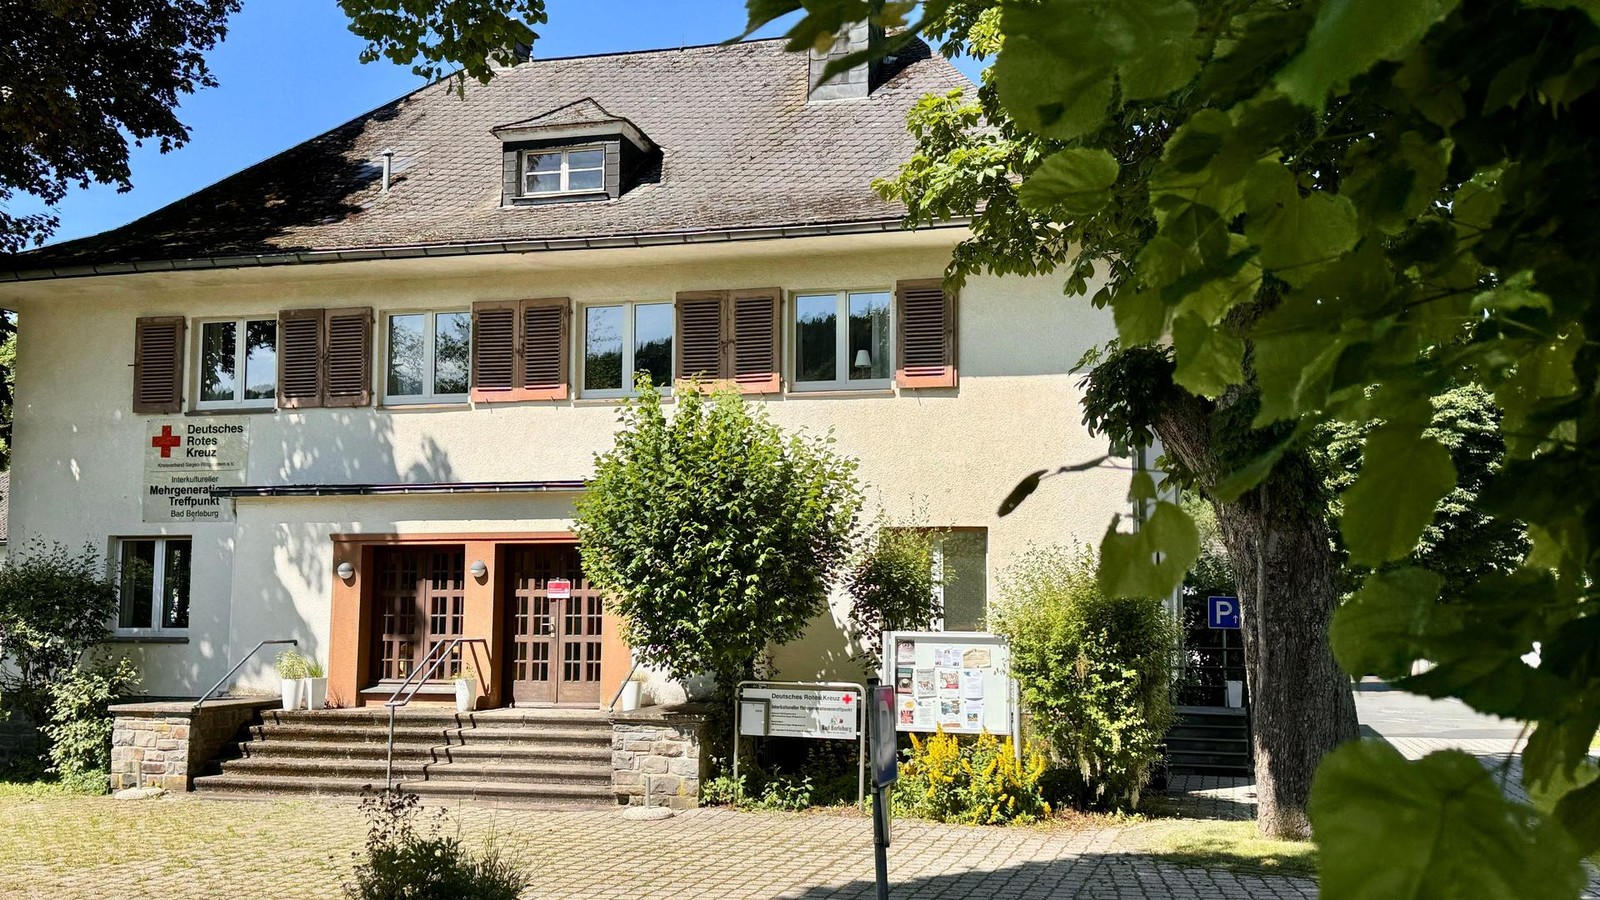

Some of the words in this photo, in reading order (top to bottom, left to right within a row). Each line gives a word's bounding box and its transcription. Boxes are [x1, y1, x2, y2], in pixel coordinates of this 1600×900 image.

[188, 424, 243, 434] Deutsches
[187, 436, 217, 445] Rotes
[186, 448, 216, 457] Kreuz
[169, 497, 219, 507] Treffpunkt
[186, 510, 218, 518] Berleburg
[1216, 601, 1233, 624] P
